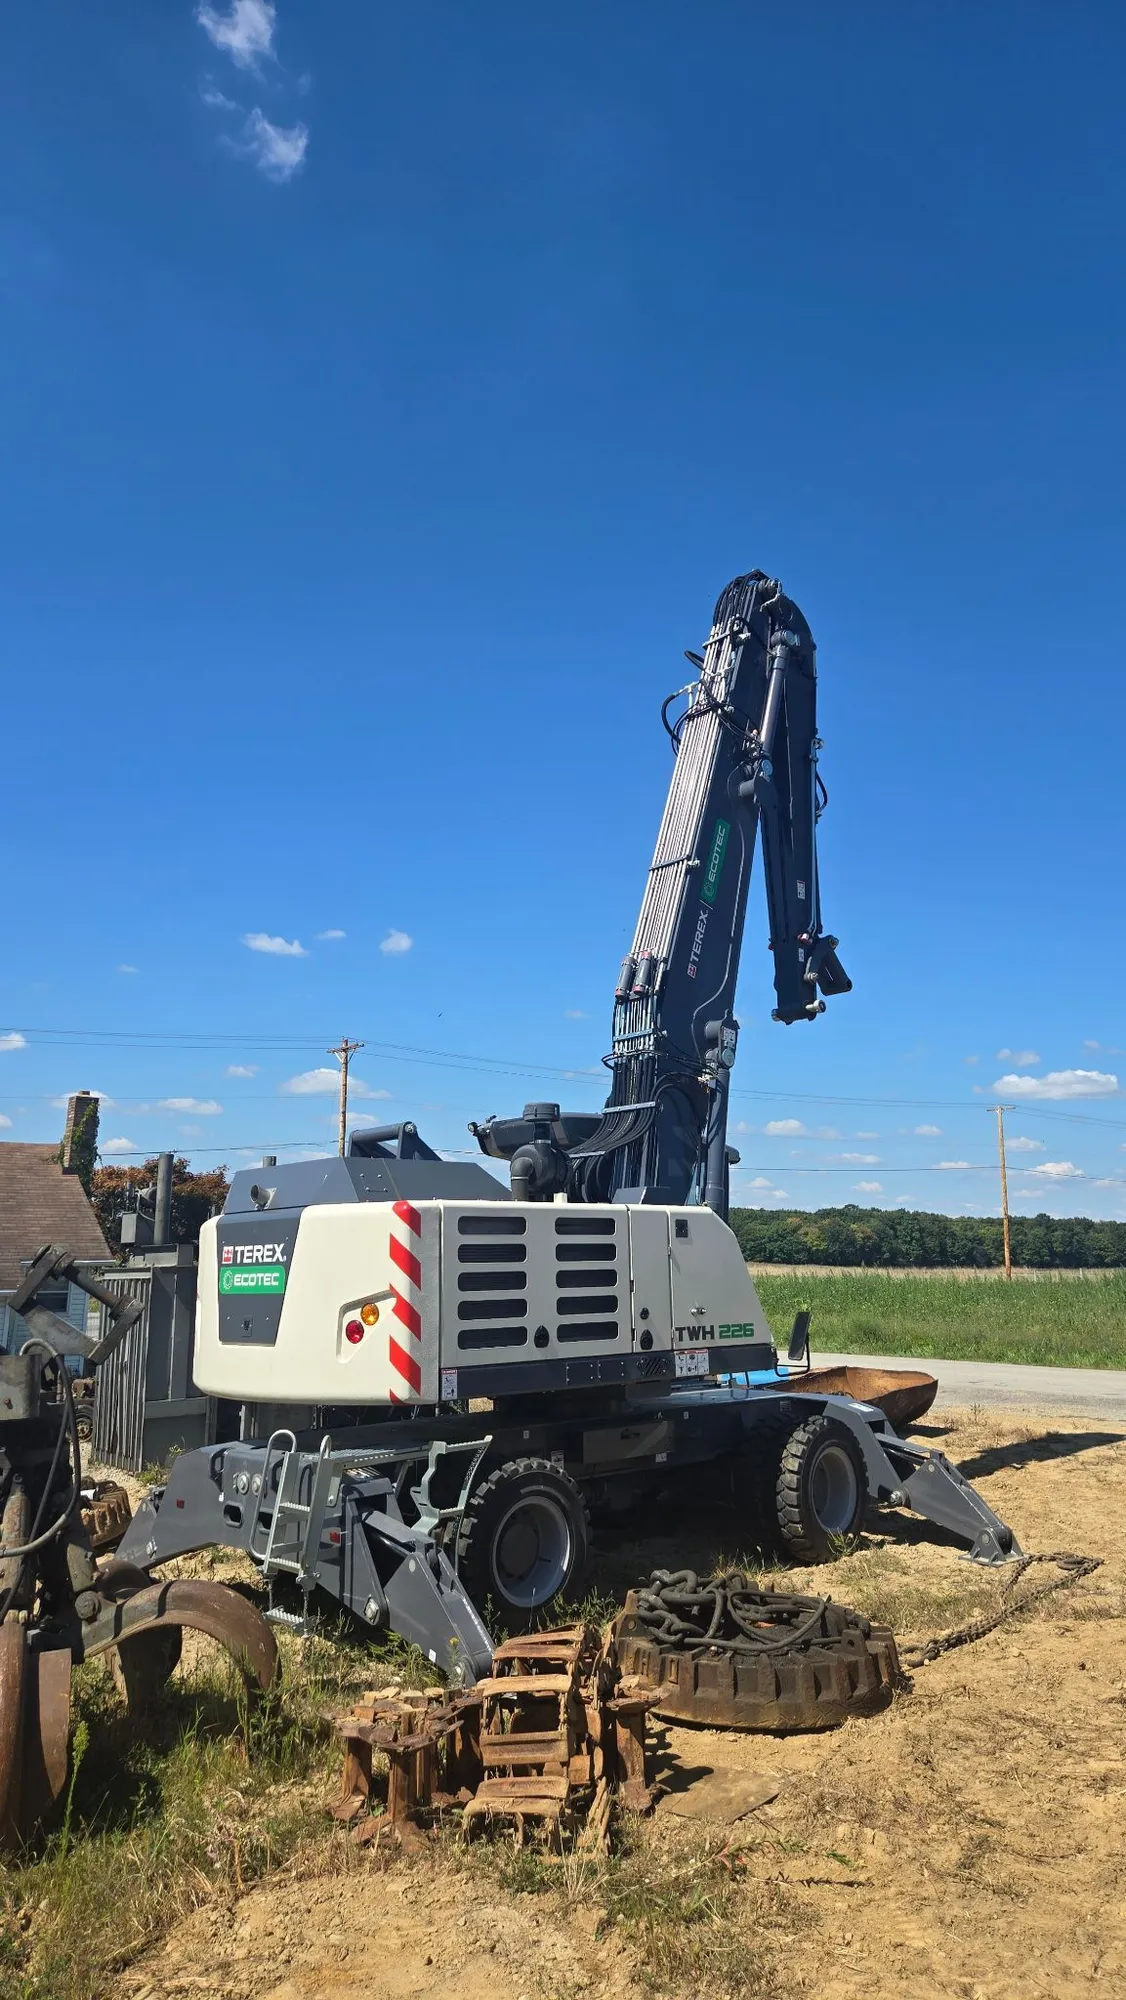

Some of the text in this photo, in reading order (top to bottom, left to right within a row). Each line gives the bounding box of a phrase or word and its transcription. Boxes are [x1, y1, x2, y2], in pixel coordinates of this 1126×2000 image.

[708, 825, 726, 883] ECOTEC
[690, 910, 708, 963] TEREX
[234, 1243, 285, 1264] TEREX
[233, 1272, 280, 1287] ECOTEC
[674, 1323, 755, 1343] TWH 226
